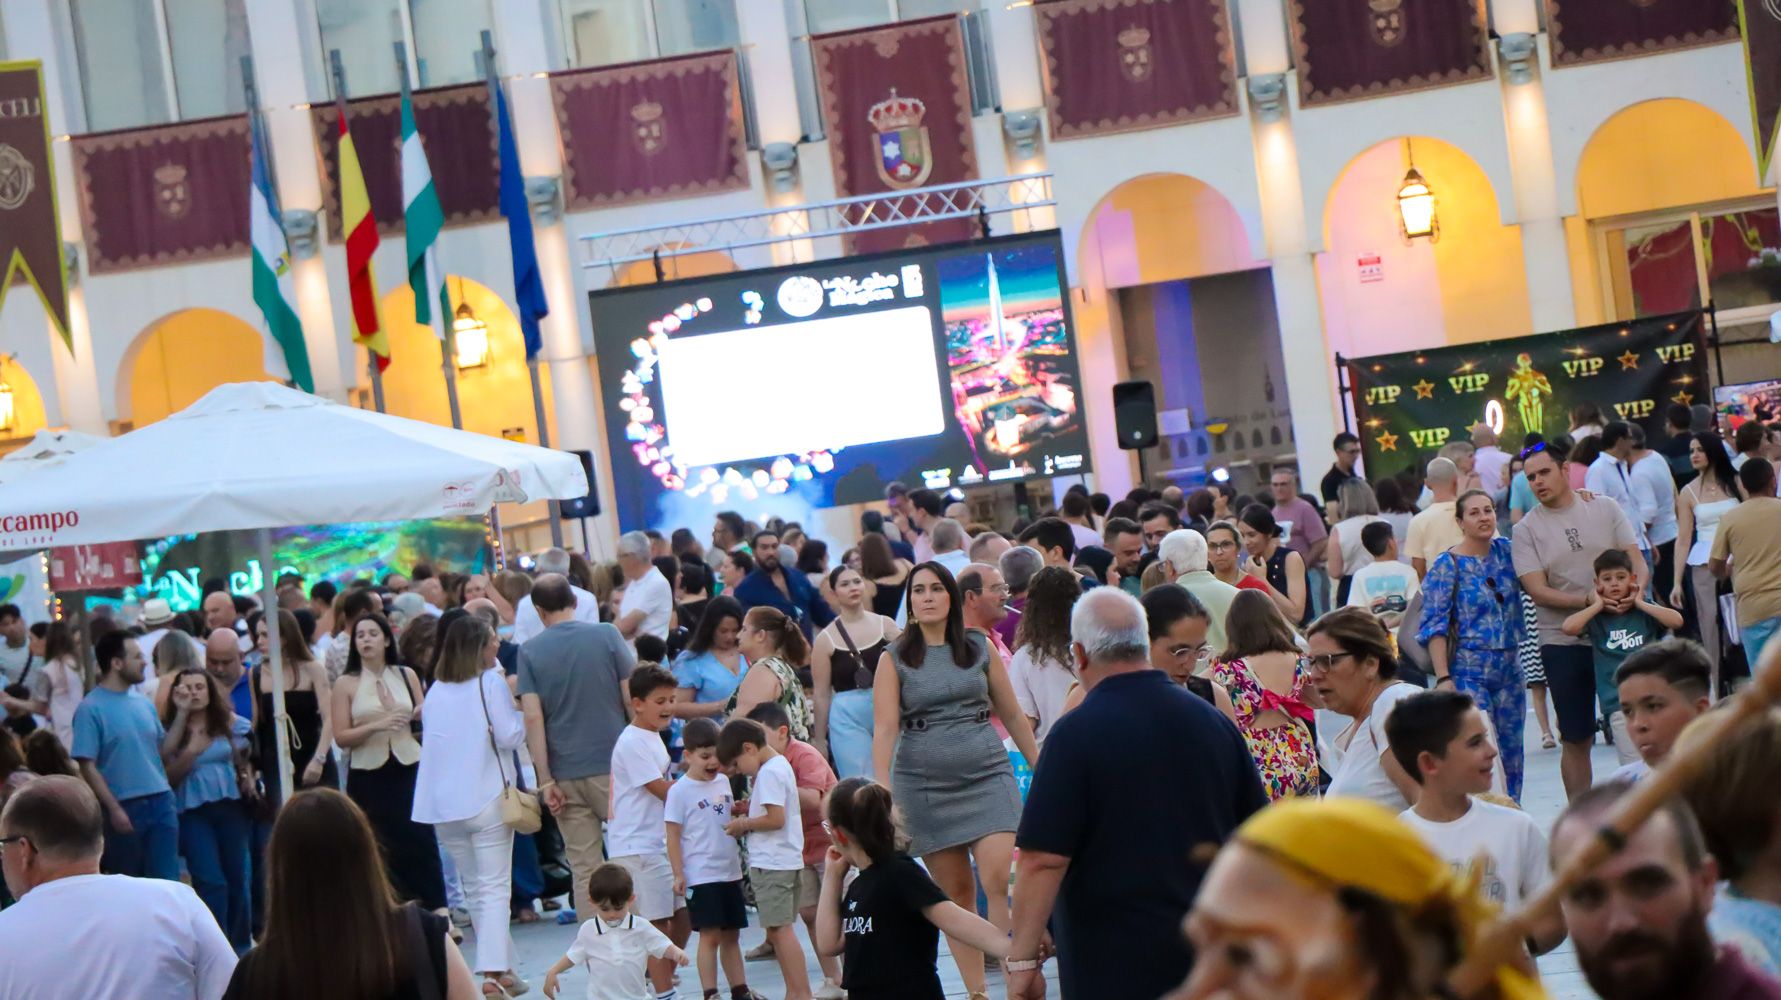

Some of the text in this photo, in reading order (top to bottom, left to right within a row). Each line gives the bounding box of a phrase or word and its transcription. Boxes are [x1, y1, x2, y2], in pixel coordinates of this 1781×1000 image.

[1655, 343, 1695, 364] VIP
[1562, 357, 1604, 378] VIP
[1448, 373, 1490, 394] VIP
[1365, 385, 1401, 405] VIP
[1613, 400, 1655, 420] VIP
[1409, 427, 1450, 448] VIP
[0, 510, 79, 532] campo
[1610, 629, 1627, 640] JUST
